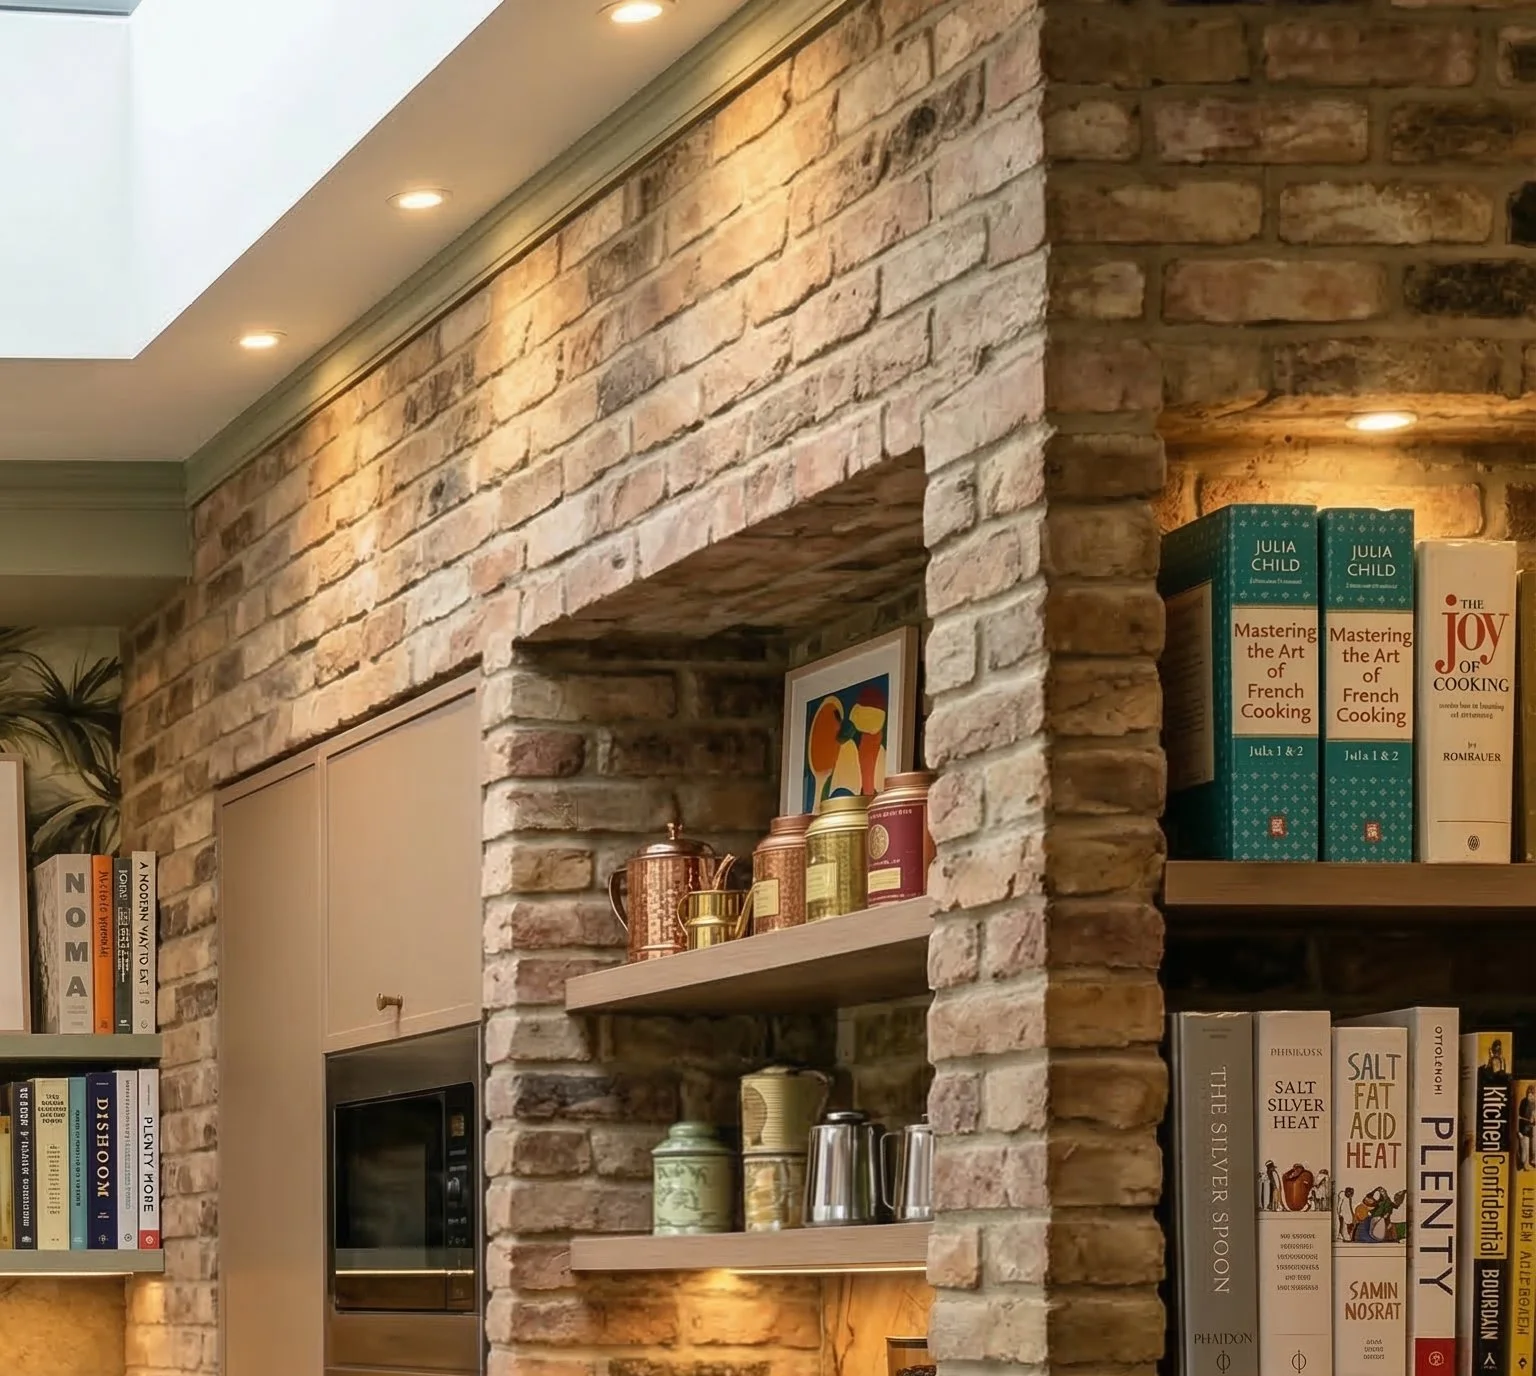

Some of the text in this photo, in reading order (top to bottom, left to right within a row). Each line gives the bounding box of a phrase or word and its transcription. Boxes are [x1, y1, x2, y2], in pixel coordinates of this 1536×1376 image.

[1255, 540, 1296, 554] JULIA
[1351, 545, 1393, 560] JULIA
[1251, 557, 1300, 572] CHILD
[1347, 562, 1396, 577] CHILD
[1459, 599, 1484, 610] THE
[1234, 623, 1317, 643] Mastering
[1329, 628, 1413, 648] Mastering
[1247, 644, 1305, 660] the Art
[1342, 649, 1401, 664] the Art
[1267, 663, 1286, 678] of
[1362, 667, 1381, 683] of
[1460, 660, 1481, 674] OF
[1247, 683, 1305, 699] French
[1433, 677, 1509, 693] COOKING
[1343, 688, 1399, 703] French
[1241, 703, 1311, 724] Cooking
[1336, 708, 1407, 728] Cooking
[1277, 746, 1281, 757] 1
[1285, 746, 1295, 757] &
[1297, 746, 1304, 756] 2
[1381, 751, 1390, 761] &
[1392, 751, 1399, 761] 2
[139, 862, 148, 870] A
[65, 872, 89, 998] NOMA
[138, 925, 149, 950] WAY
[139, 952, 149, 965] TO
[139, 969, 149, 986] EAT
[1347, 1053, 1402, 1081] SALT
[1275, 1081, 1317, 1095] SALT
[1354, 1082, 1395, 1110] FAT
[1267, 1098, 1325, 1112] SILVER
[1273, 1115, 1320, 1130] HEAT
[1350, 1112, 1397, 1140] ACID
[96, 1097, 110, 1197] DISHOOM
[143, 1116, 154, 1168] PLENTY
[1346, 1142, 1402, 1169] HEAT
[1480, 1086, 1507, 1257] Kitchen Confidential
[1211, 1066, 1230, 1294] THE SILVER SPOON
[1418, 1117, 1455, 1296] PLENTY
[1349, 1280, 1399, 1301] SAMIN
[1345, 1302, 1402, 1321] NOSRAT
[1480, 1269, 1500, 1341] BOURDAIN
[1193, 1333, 1253, 1345] PHAIDON
